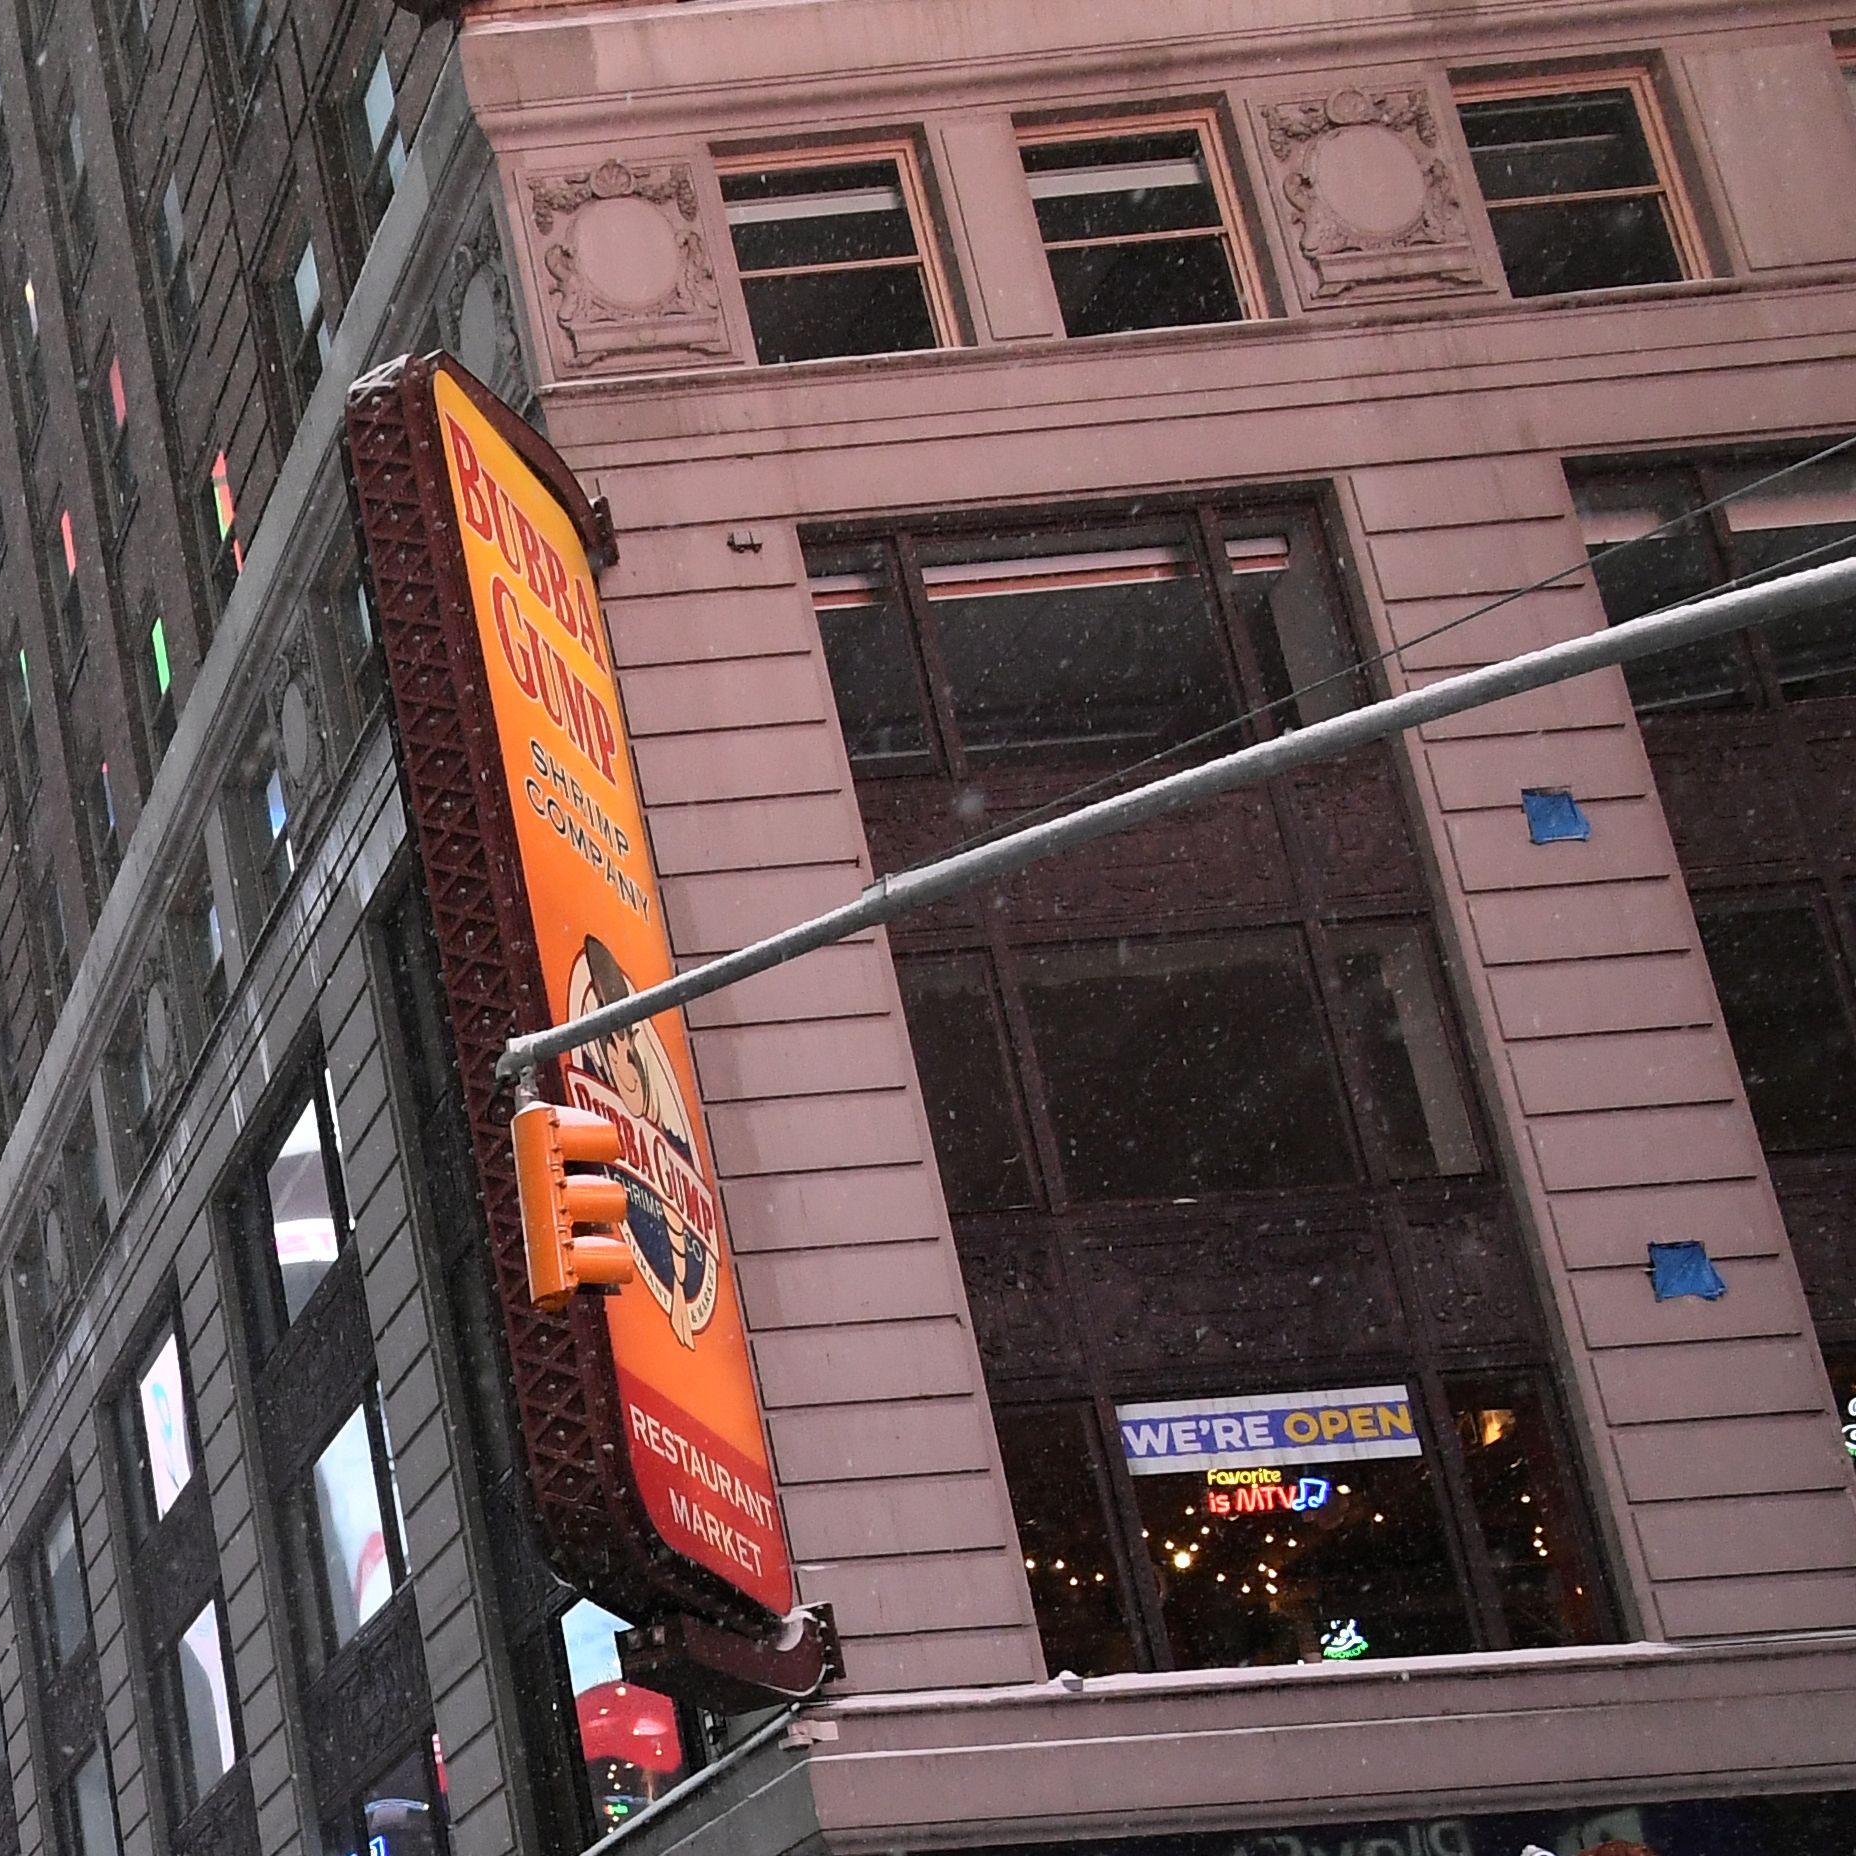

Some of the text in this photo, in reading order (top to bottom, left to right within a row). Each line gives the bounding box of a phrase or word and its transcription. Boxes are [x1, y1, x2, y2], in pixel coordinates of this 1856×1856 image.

[445, 411, 608, 675] BUBBA
[492, 575, 617, 788] GUMP
[525, 778, 652, 925] COMPANY
[531, 738, 631, 857] SHRIMP
[629, 1403, 774, 1532] RESTAURANT
[1122, 1403, 1414, 1456] WE'RE OPEN
[1207, 1468, 1282, 1489] Favorite
[668, 1486, 763, 1578] MARKET
[1209, 1485, 1297, 1514] is MTV
